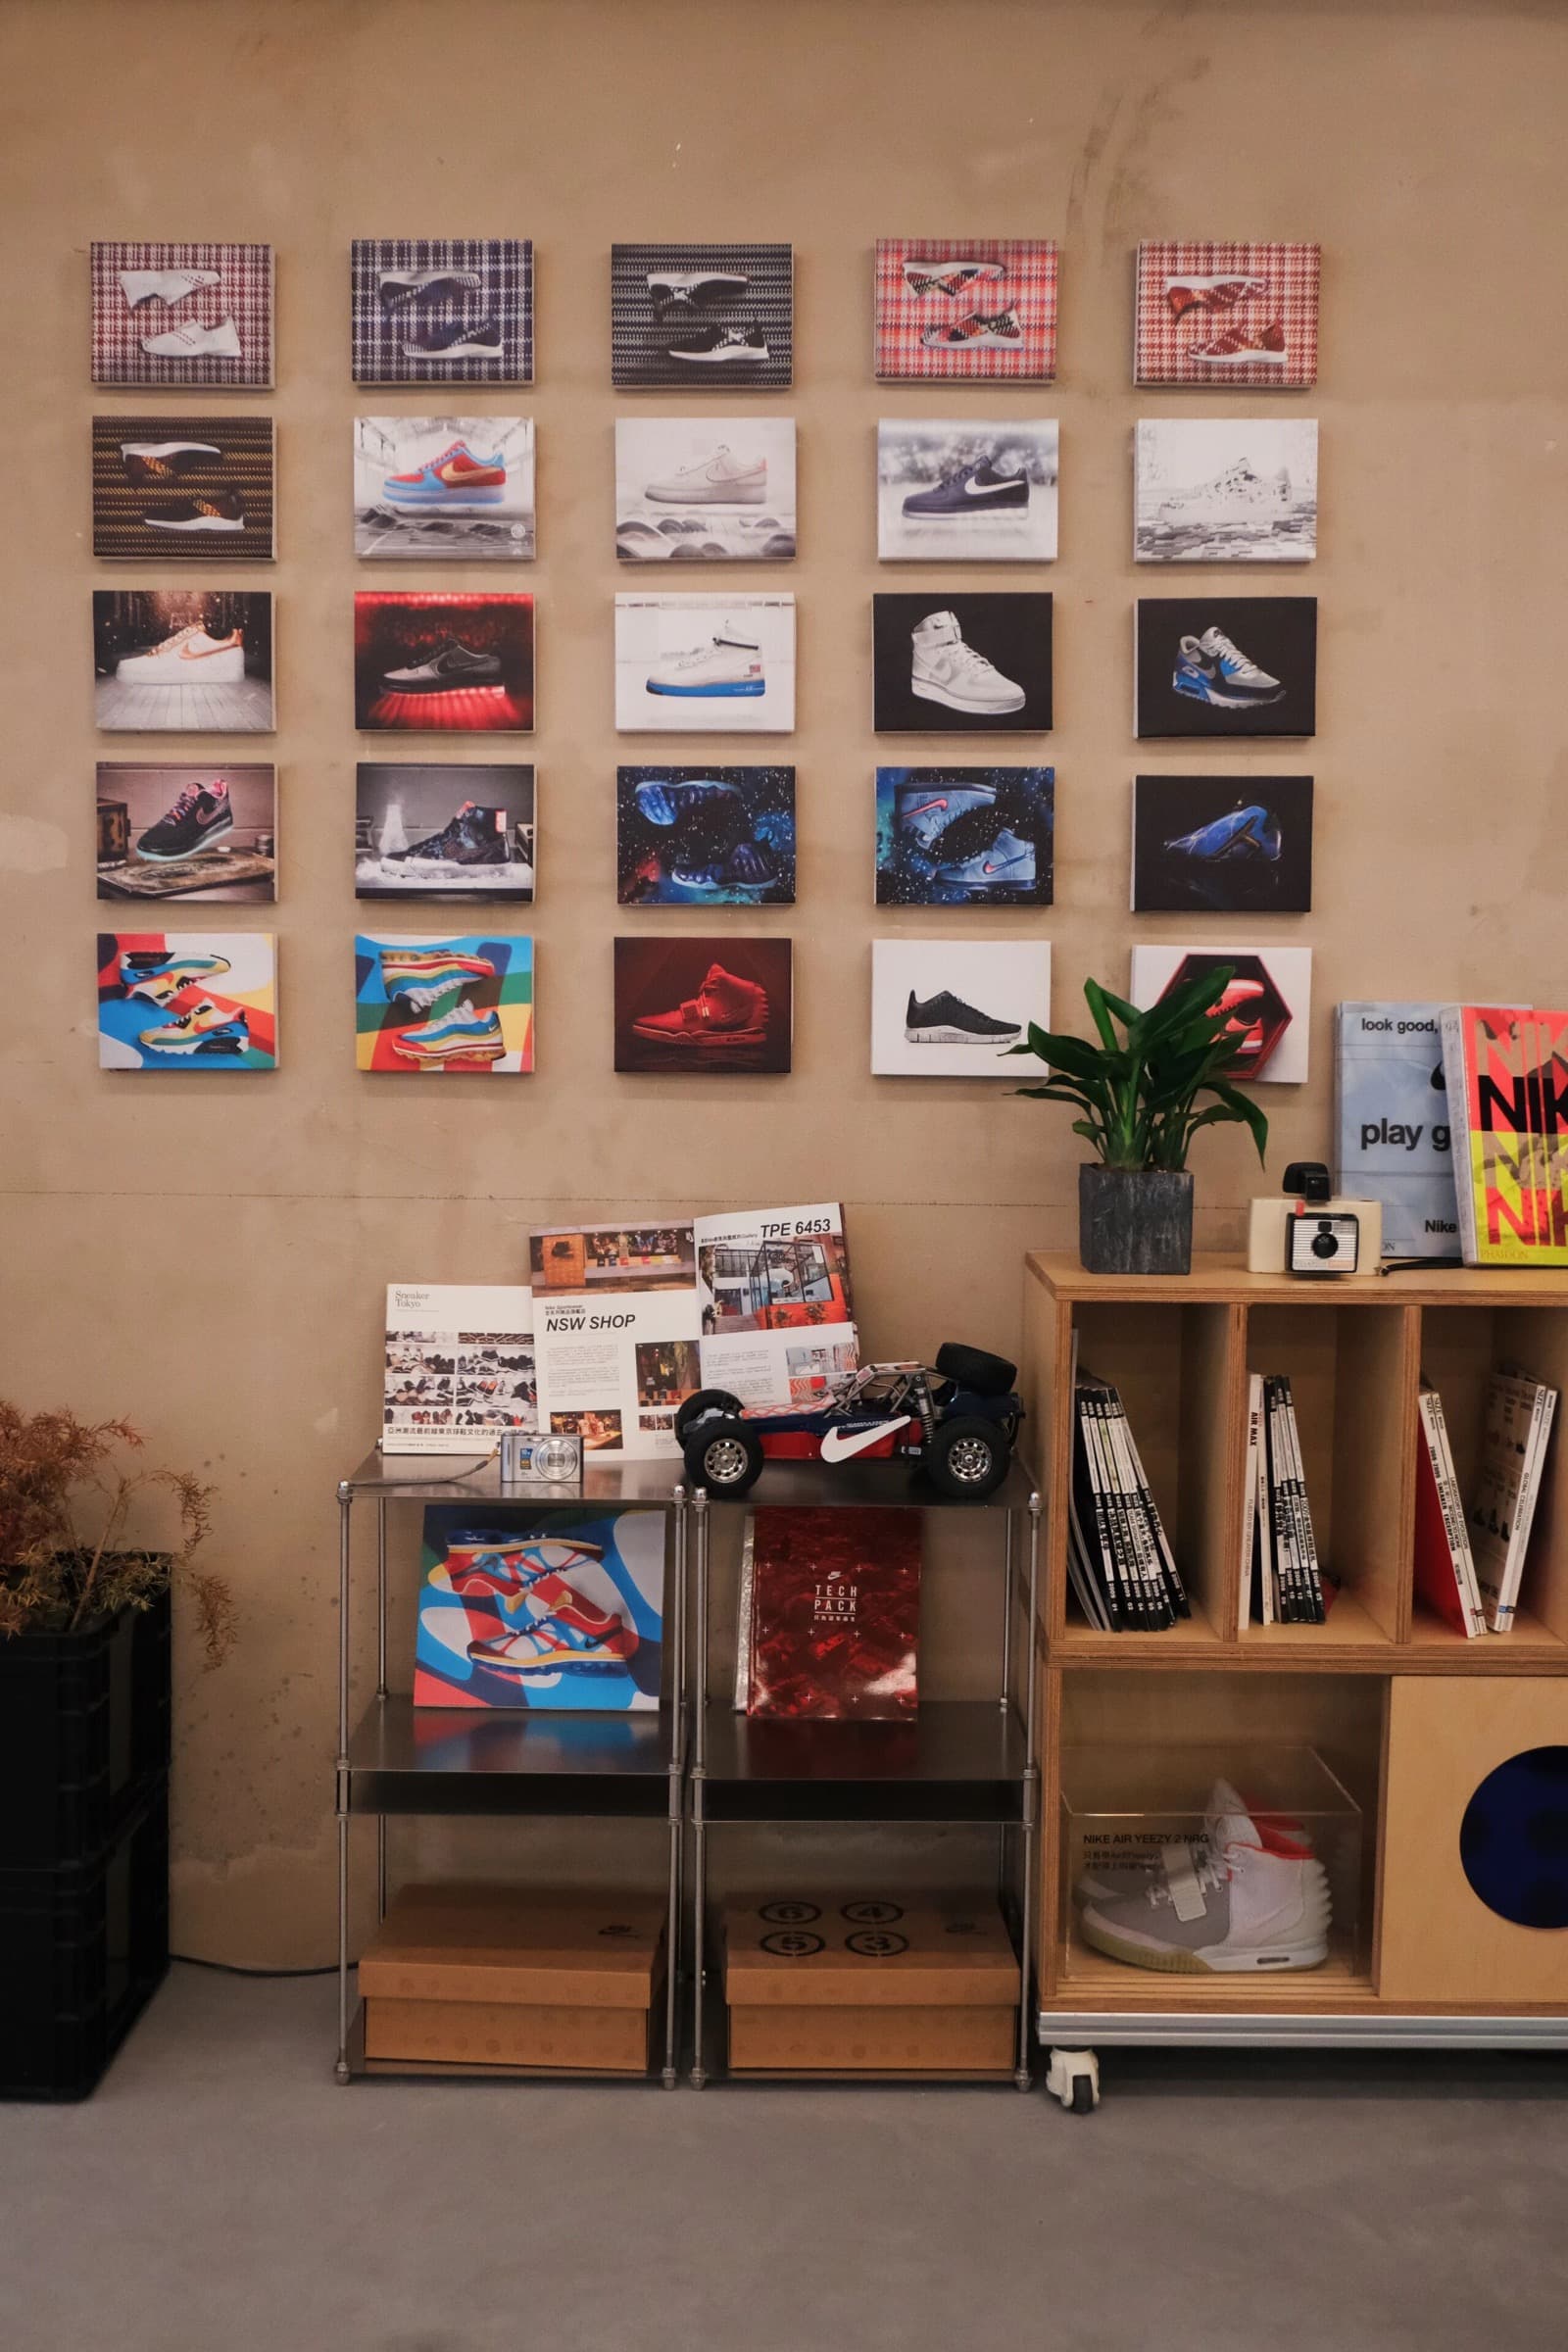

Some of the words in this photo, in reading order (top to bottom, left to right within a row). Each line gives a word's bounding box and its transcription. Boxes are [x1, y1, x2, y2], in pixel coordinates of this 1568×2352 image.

[1361, 1018, 1393, 1032] look
[1397, 1019, 1439, 1034] good,
[1361, 1118, 1423, 1151] play
[760, 1222, 791, 1238] TPE
[795, 1218, 831, 1235] 6453
[1425, 1219, 1457, 1233] Nike
[395, 1290, 431, 1299] Sneaker
[395, 1298, 421, 1309] Tokyo
[546, 1316, 586, 1332] NSW
[589, 1314, 636, 1330] SHOP
[1520, 1472, 1529, 1494] GLOBAL
[814, 1585, 858, 1597] TECH
[814, 1599, 857, 1612] PACK
[1083, 1834, 1110, 1843] NIKE
[1112, 1834, 1133, 1843] AIR
[1134, 1834, 1173, 1843] YEEZY
[1174, 1834, 1183, 1843] 2
[1184, 1834, 1209, 1843] NRG
